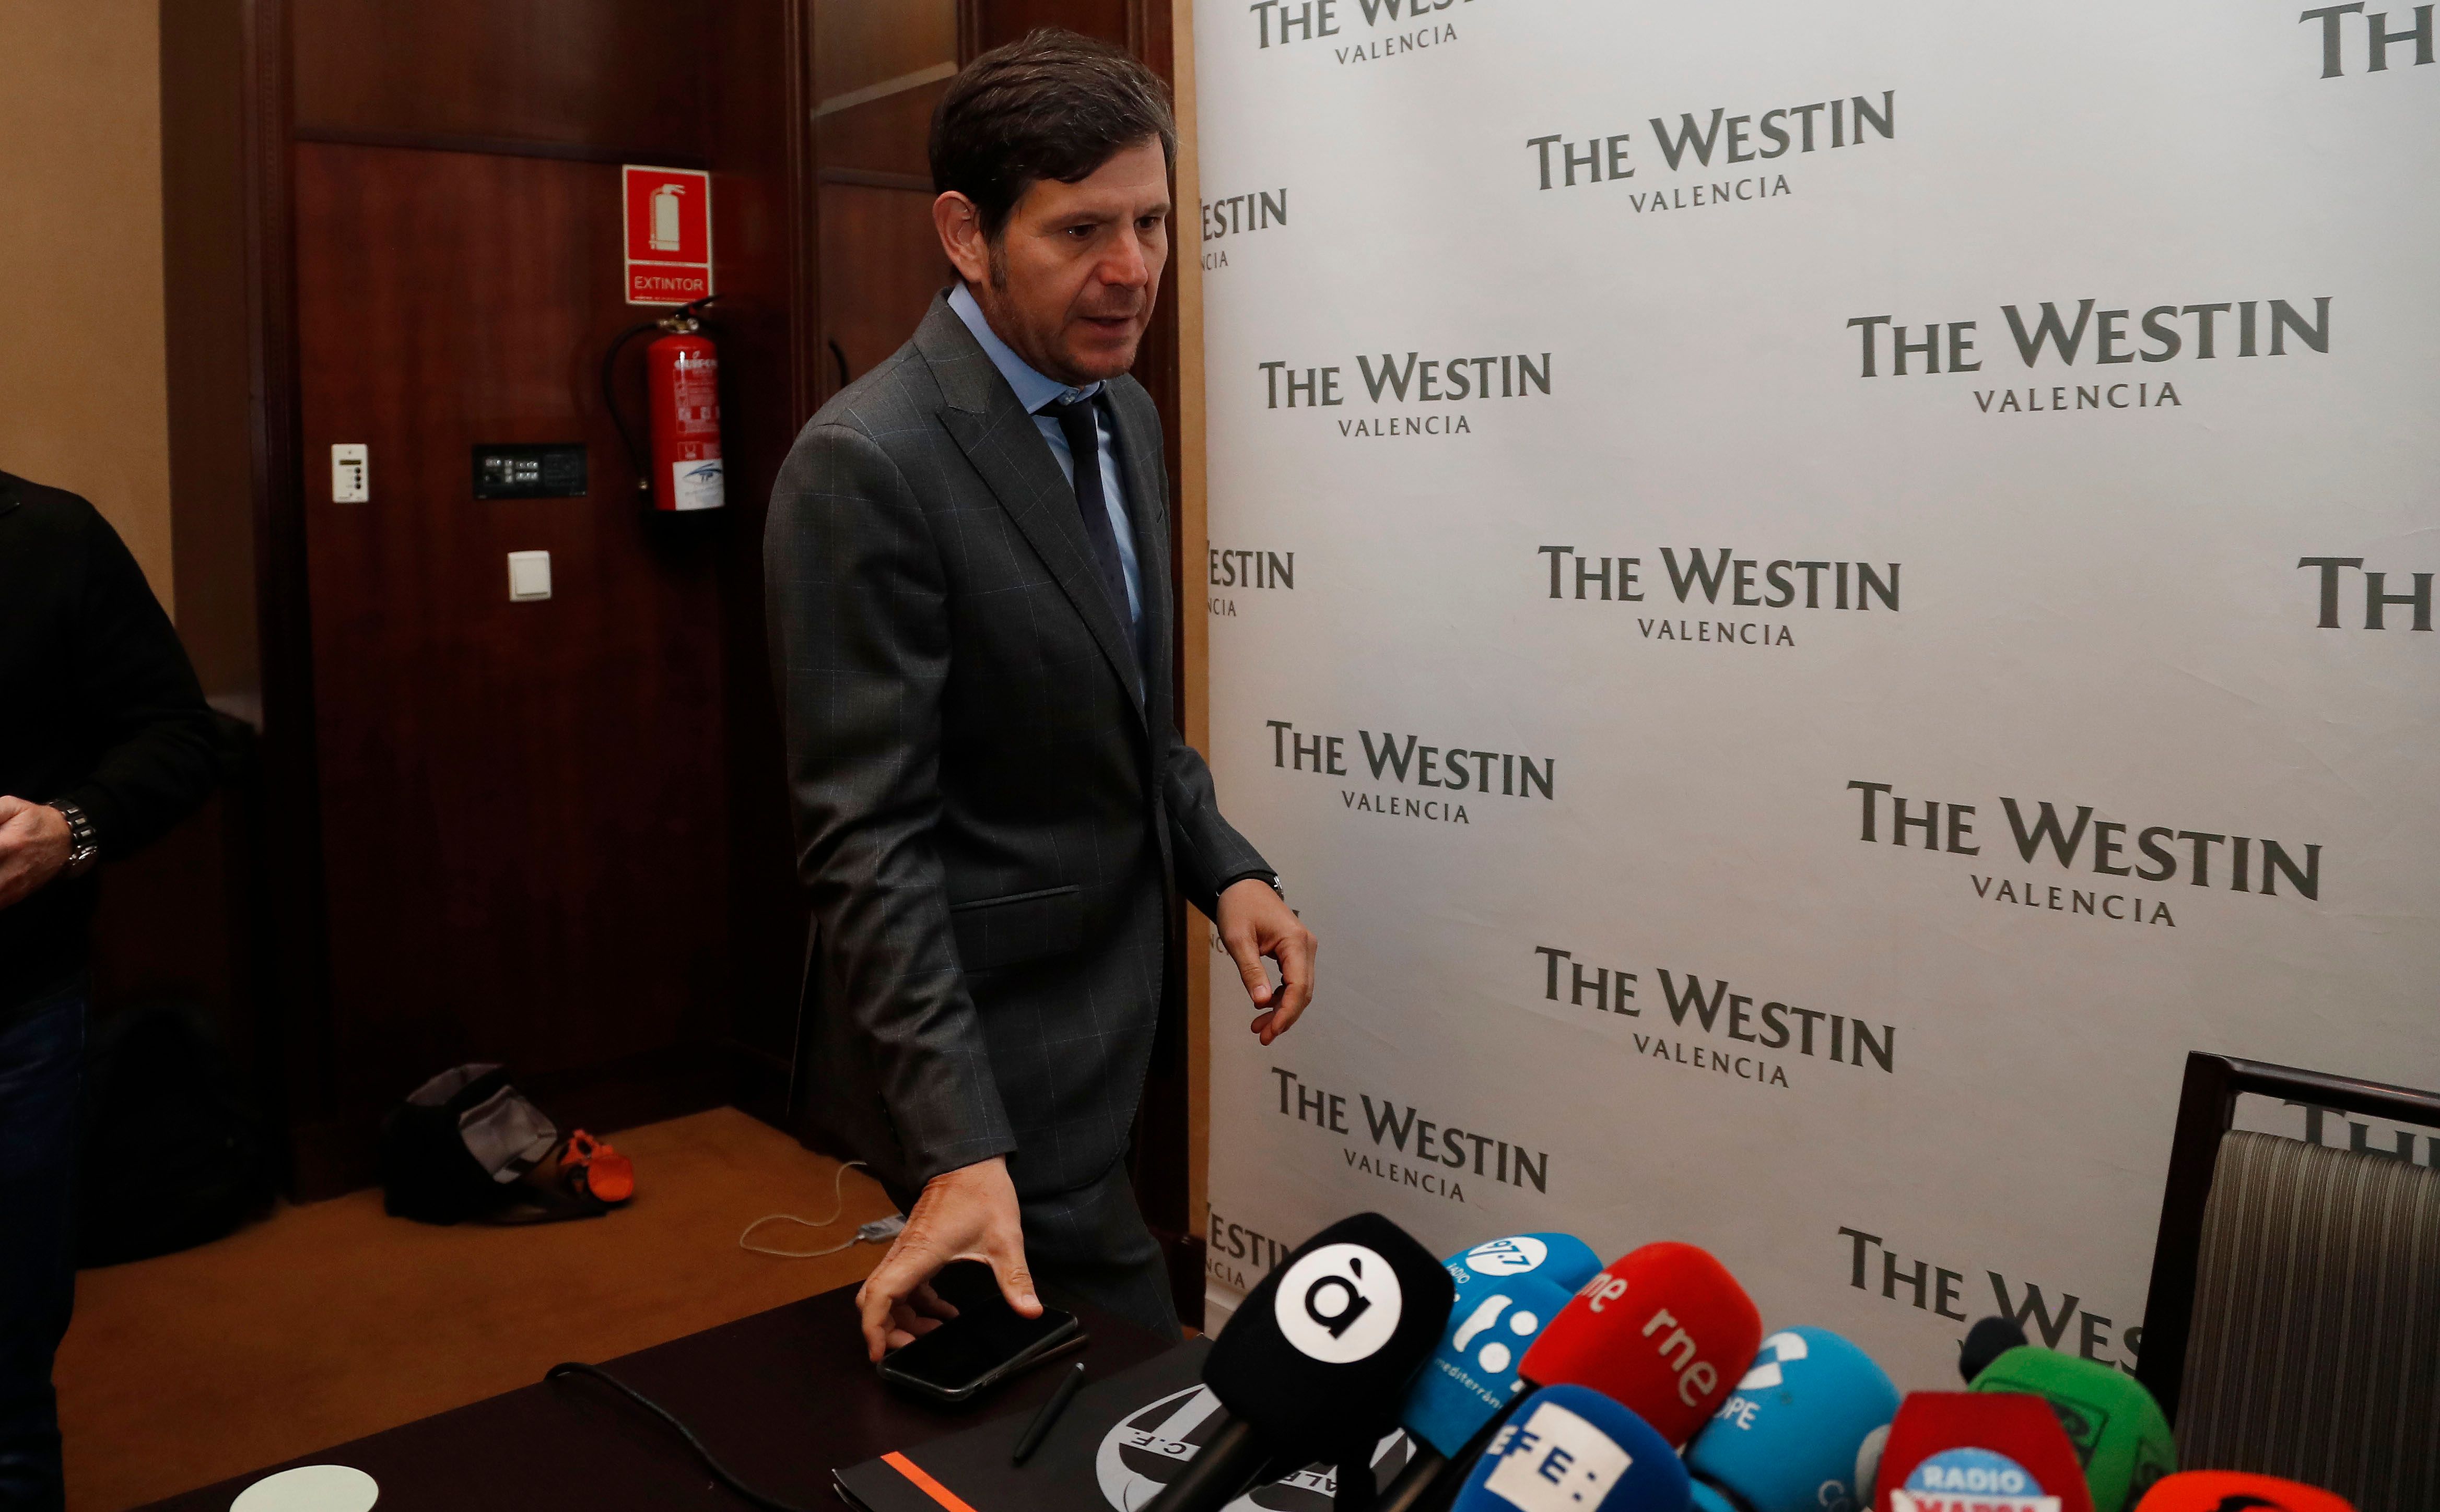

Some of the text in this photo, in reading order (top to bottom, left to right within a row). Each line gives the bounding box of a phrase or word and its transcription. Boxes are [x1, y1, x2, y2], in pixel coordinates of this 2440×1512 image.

[1250, 0, 1340, 49] THE
[1335, 23, 1458, 65] VALENCIA
[1526, 90, 1895, 191] THE WESTIN
[1201, 187, 1287, 242] ESTIN
[1629, 174, 1791, 213] VALENCIA
[634, 276, 704, 291] EXTINTOR
[1846, 296, 2333, 378] THE WESTIN
[1258, 352, 1552, 409] THE WESTIN
[1973, 382, 2183, 413] VALENCIA
[1338, 415, 1471, 437] VALENCIA
[1207, 543, 1295, 590] ESTIN
[1537, 545, 1902, 612] THE WESTIN
[1637, 618, 1796, 647] VALENCIA
[1266, 719, 1555, 801] THE WESTIN
[1341, 790, 1470, 824] VALENCIA
[1846, 780, 2323, 902] THE WESTIN
[1970, 874, 2176, 927] VALENCIA
[1534, 946, 1896, 1074] THE WESTIN
[1633, 1033, 1790, 1089] VALENCIA
[1271, 1066, 1549, 1195] THE WESTIN
[2283, 1098, 2440, 1170] TH
[1343, 1148, 1465, 1203] VALENCIA
[1207, 1202, 1291, 1272] ESTI
[1837, 1226, 1968, 1323] THE
[1435, 1358, 1503, 1409] mediterrán
[1643, 1308, 1718, 1407] rne
[1922, 1464, 2025, 1494] RADIO
